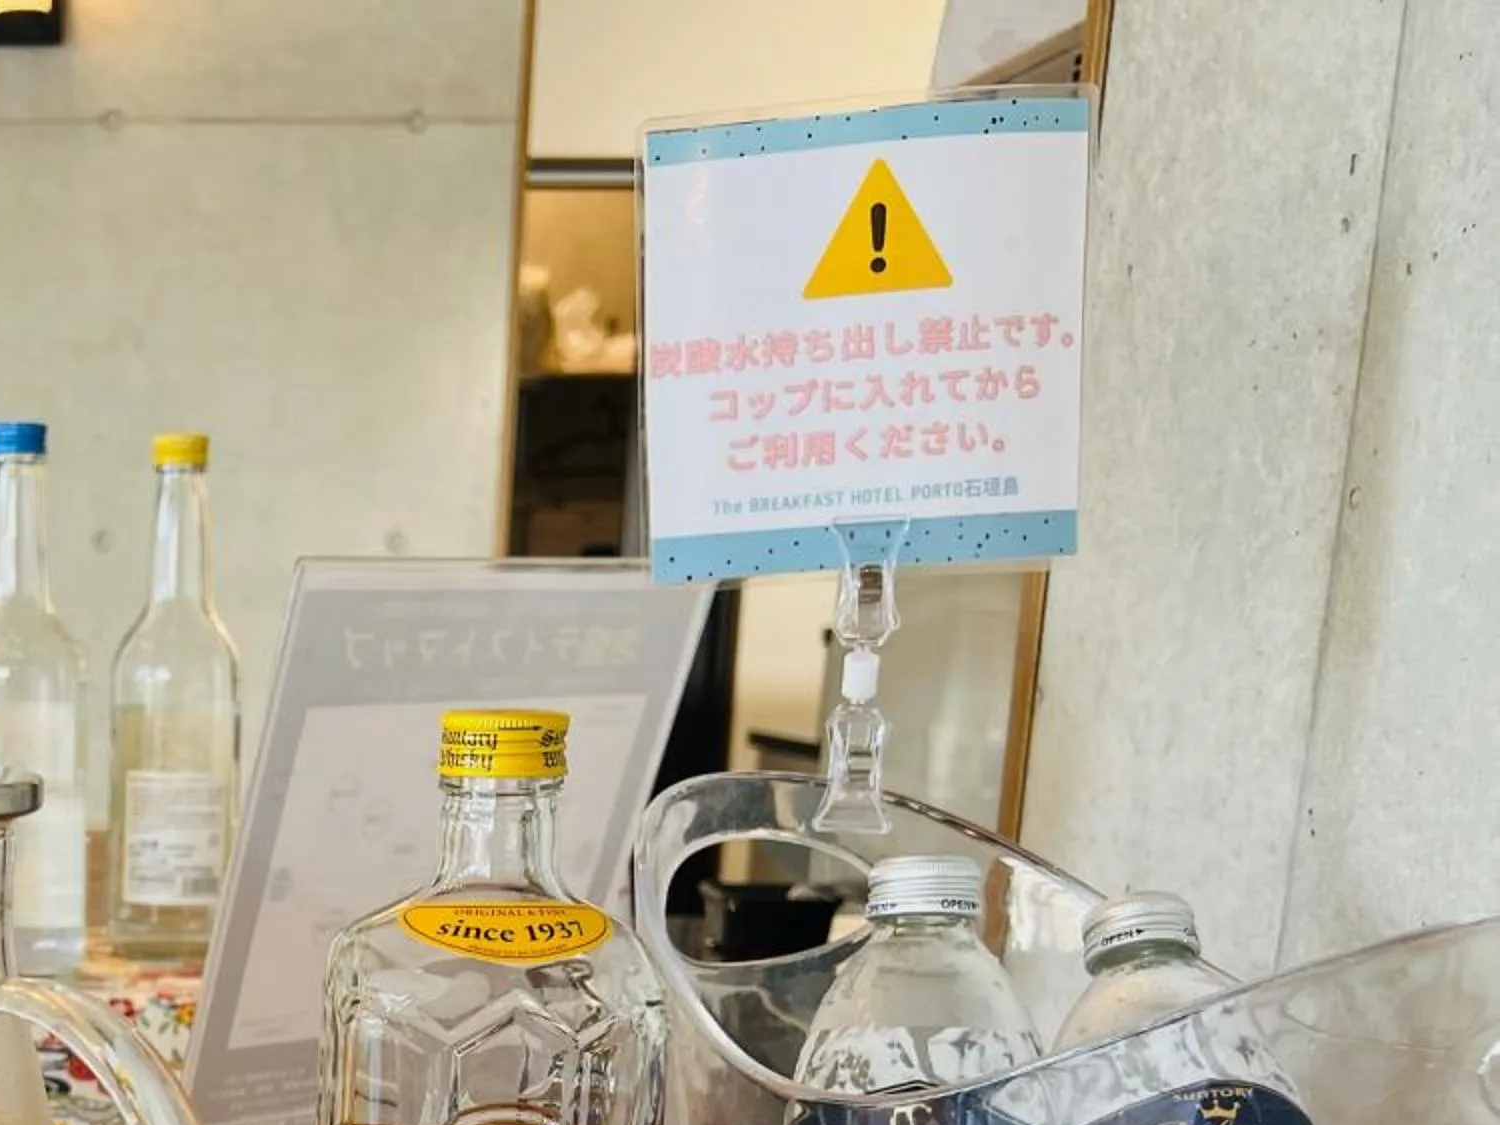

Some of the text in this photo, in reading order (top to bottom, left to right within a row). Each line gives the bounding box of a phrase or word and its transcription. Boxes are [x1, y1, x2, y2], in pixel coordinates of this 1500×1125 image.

[708, 365, 1041, 422] コップに入れてから
[726, 420, 1007, 472] ご利用ください。
[749, 491, 845, 514] BREAKFAST
[851, 486, 902, 506] HOTEL
[436, 918, 584, 942] since 1937
